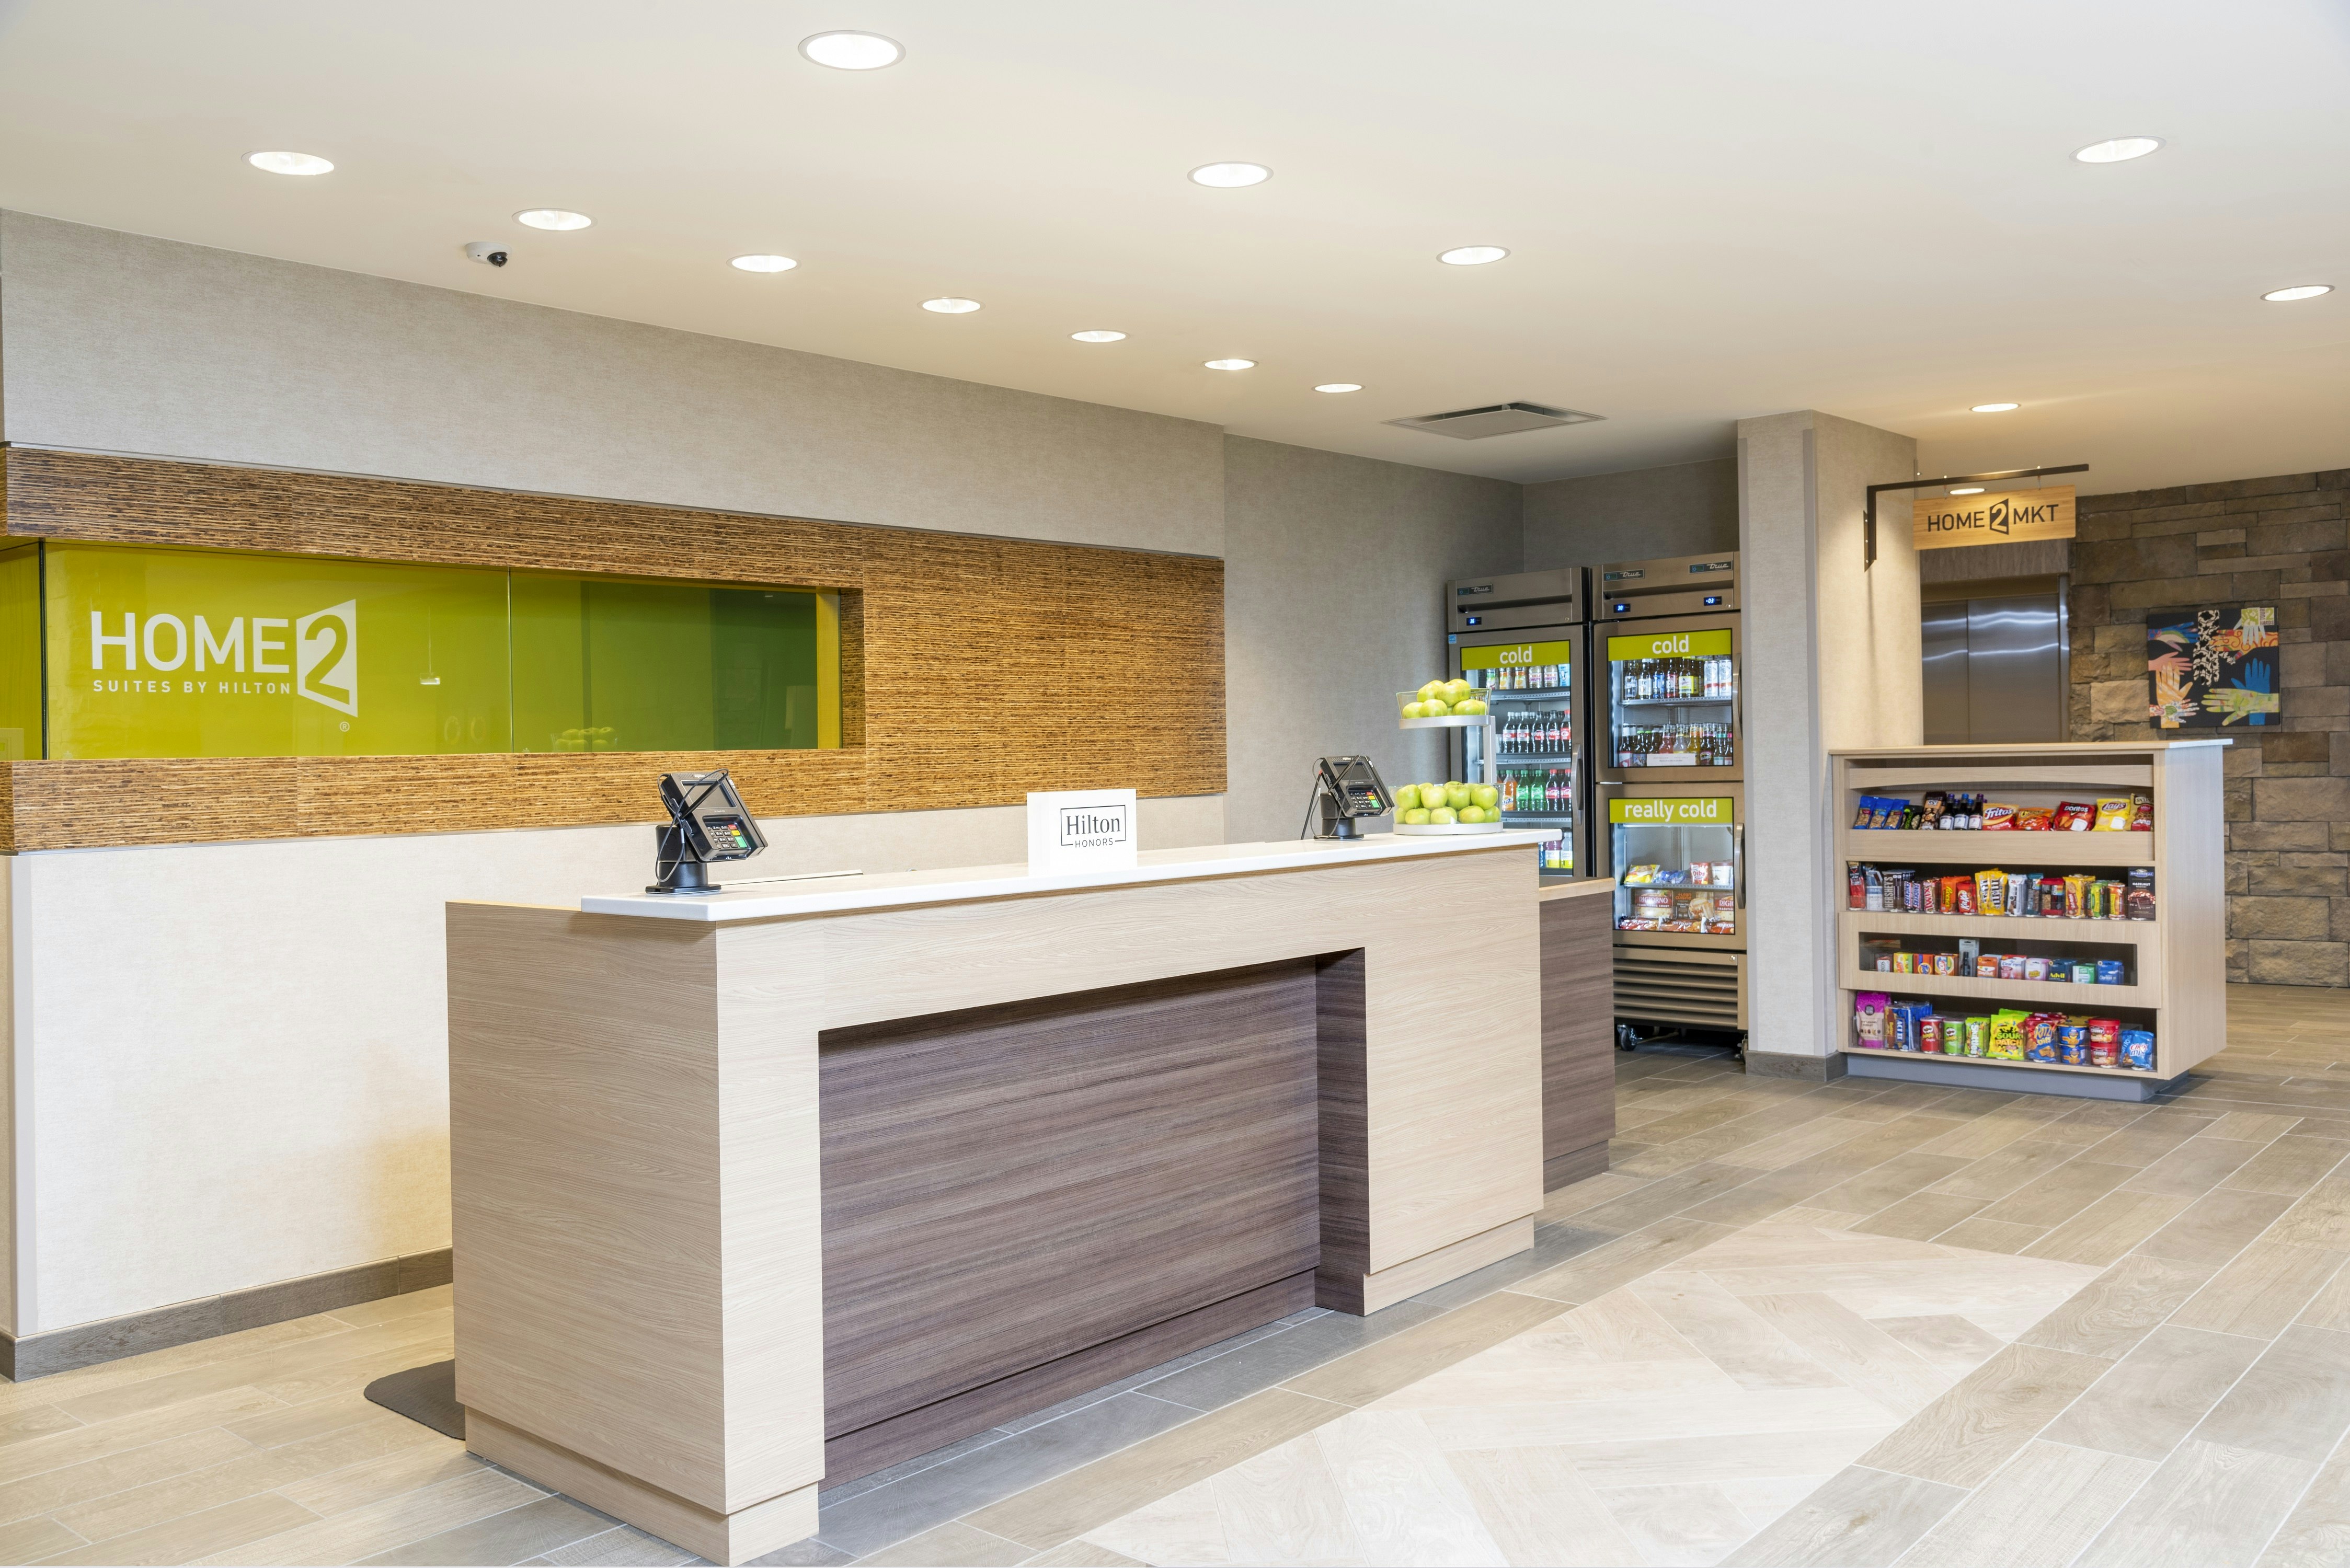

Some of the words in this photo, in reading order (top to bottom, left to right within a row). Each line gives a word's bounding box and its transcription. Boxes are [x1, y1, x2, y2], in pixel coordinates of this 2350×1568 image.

[2013, 504, 2059, 524] MKT
[1652, 635, 1689, 654] cold
[1499, 645, 1532, 664] cold
[93, 679, 170, 693] SUITES
[184, 681, 207, 693] BY
[219, 682, 290, 694] HILTON
[1625, 800, 1674, 822] really
[1679, 800, 1717, 817] cold
[1985, 807, 2013, 820] Fritos
[1066, 814, 1121, 835] Hilton
[1075, 837, 1114, 848] HONORS
[1884, 877, 1894, 908] HERSHEY'S
[2035, 1026, 2052, 1039] RITZ
